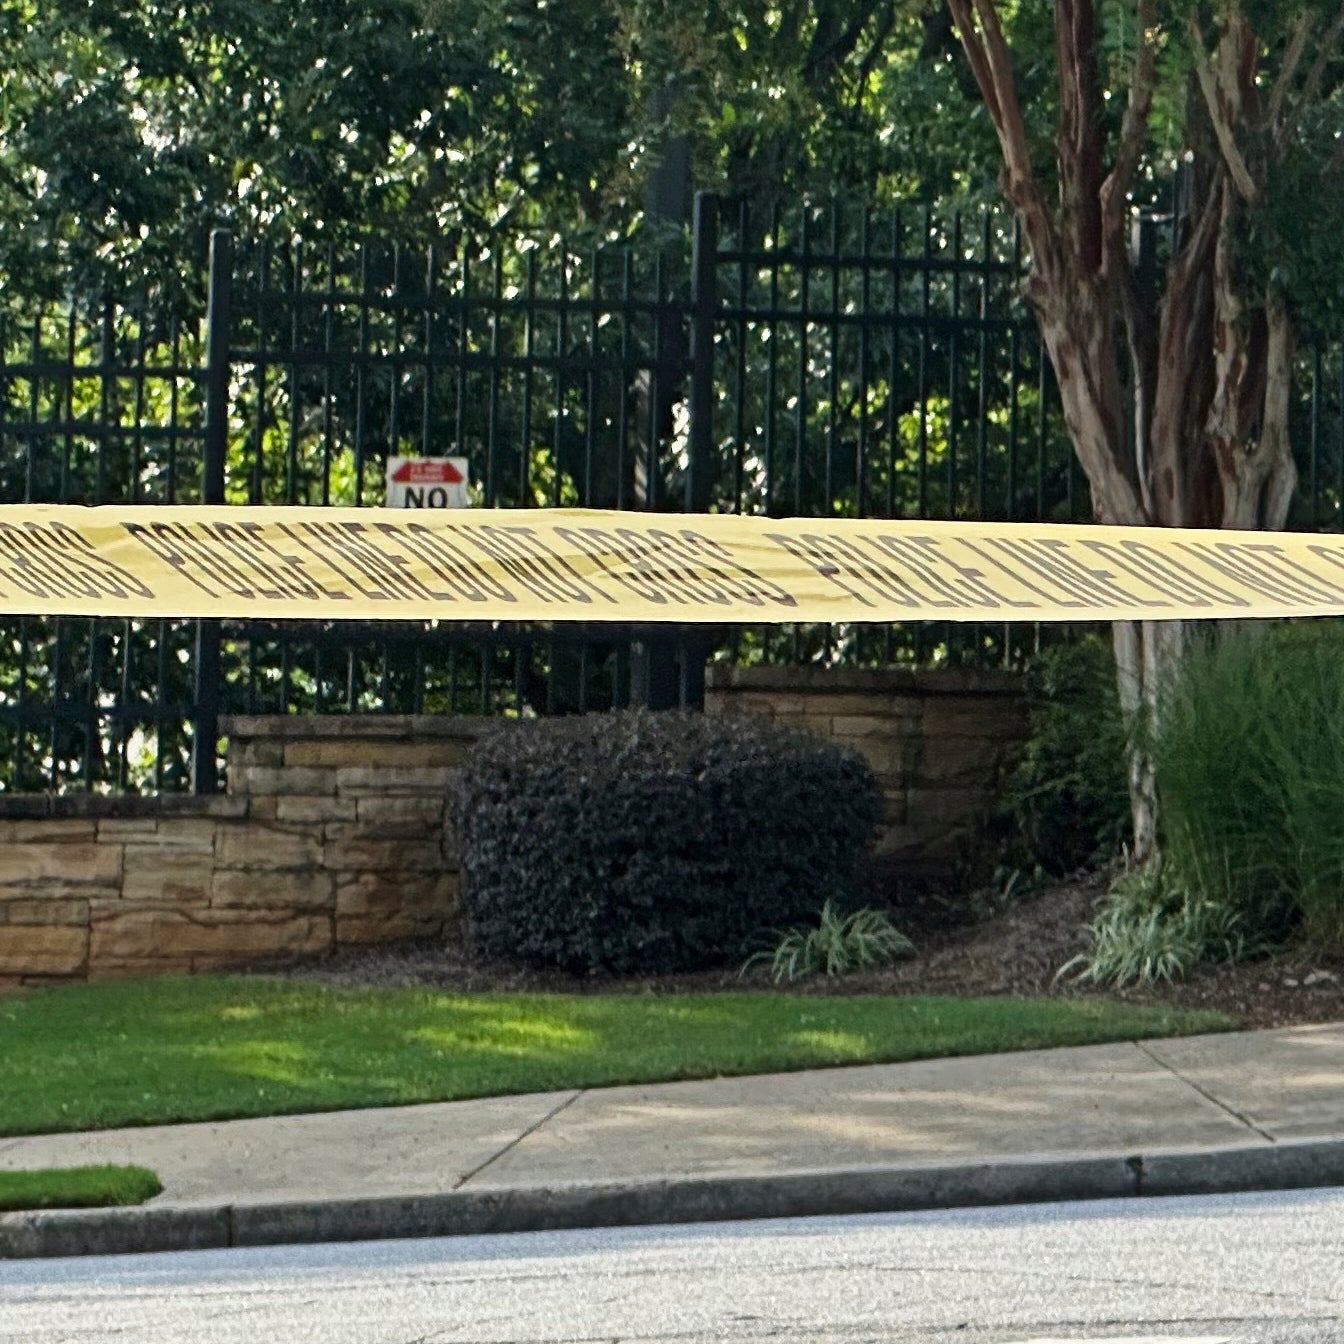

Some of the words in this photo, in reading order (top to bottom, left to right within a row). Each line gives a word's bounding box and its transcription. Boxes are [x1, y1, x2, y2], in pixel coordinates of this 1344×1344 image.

[404, 486, 449, 508] NO
[120, 521, 352, 599] POLICE
[275, 522, 458, 601] LINE
[374, 522, 517, 603] DO
[447, 524, 619, 603] NOT
[552, 526, 798, 607] CROSS
[762, 532, 1040, 608] POLICE
[952, 537, 1174, 608] LINE
[1076, 539, 1251, 607] DO
